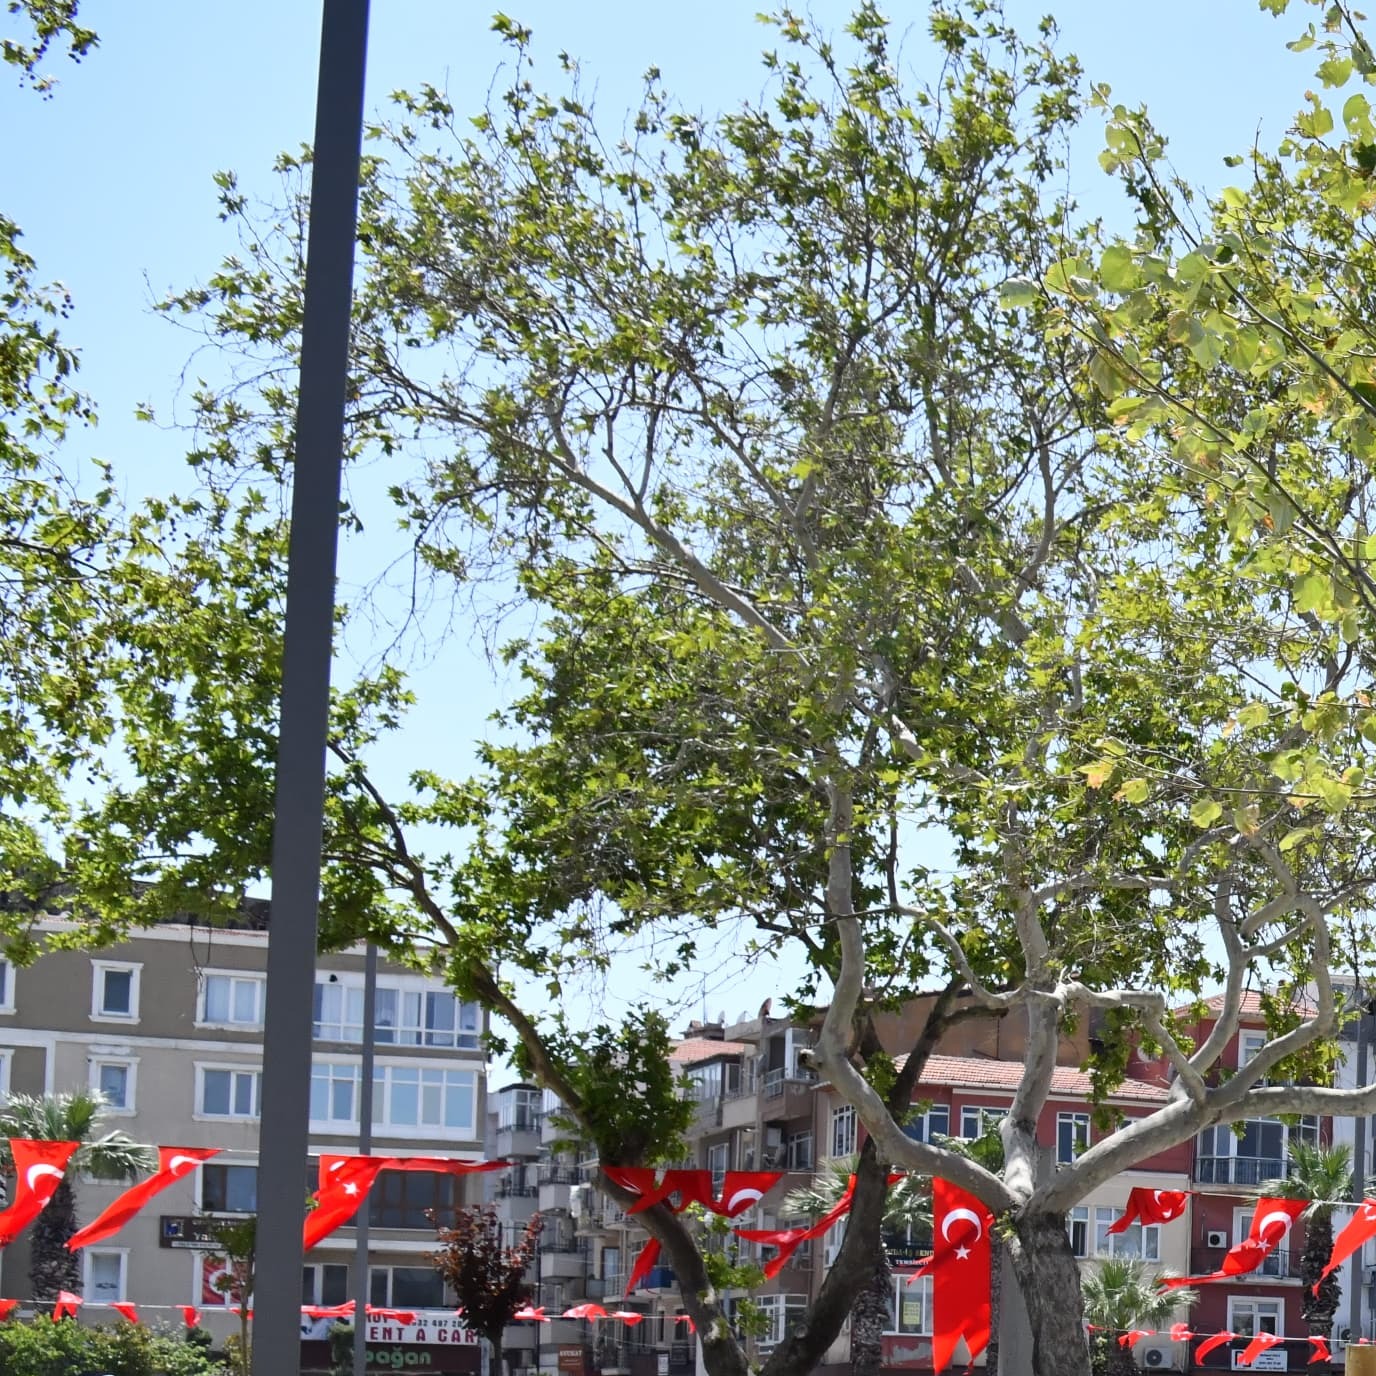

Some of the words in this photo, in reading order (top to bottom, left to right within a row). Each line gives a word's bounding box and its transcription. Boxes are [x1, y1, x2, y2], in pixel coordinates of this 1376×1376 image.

[370, 1327, 405, 1341] ENT
[416, 1328, 426, 1342] A
[438, 1329, 475, 1343] CAR
